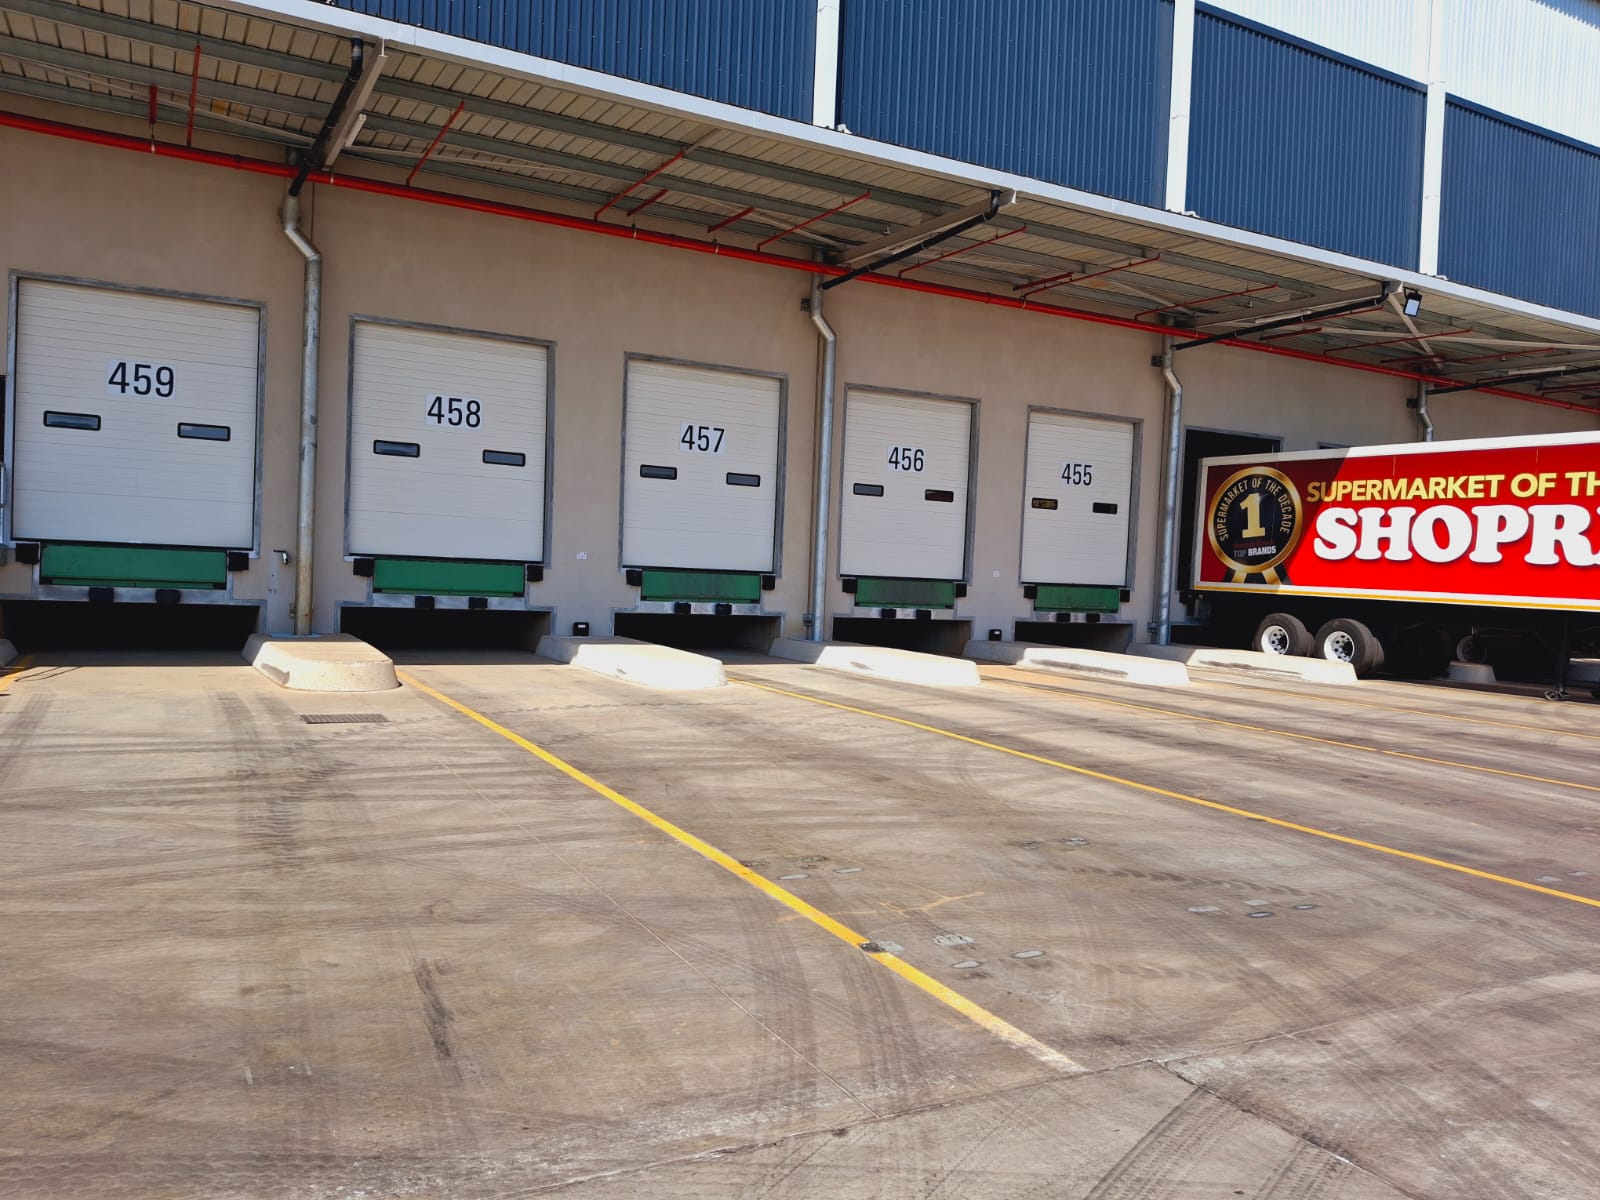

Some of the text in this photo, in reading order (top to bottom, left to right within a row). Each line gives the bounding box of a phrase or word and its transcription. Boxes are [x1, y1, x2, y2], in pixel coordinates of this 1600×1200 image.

[107, 361, 175, 398] 459
[427, 396, 481, 428] 458
[680, 424, 725, 453] 457
[888, 446, 925, 472] 456
[1061, 463, 1093, 487] 455
[1306, 474, 1505, 502] SUPERMARKET
[1510, 472, 1557, 498] OF
[1216, 478, 1293, 541] SUPERMARKET OF THE DECADE
[1239, 493, 1266, 539] 1
[1233, 545, 1277, 558] TOP BRANDS
